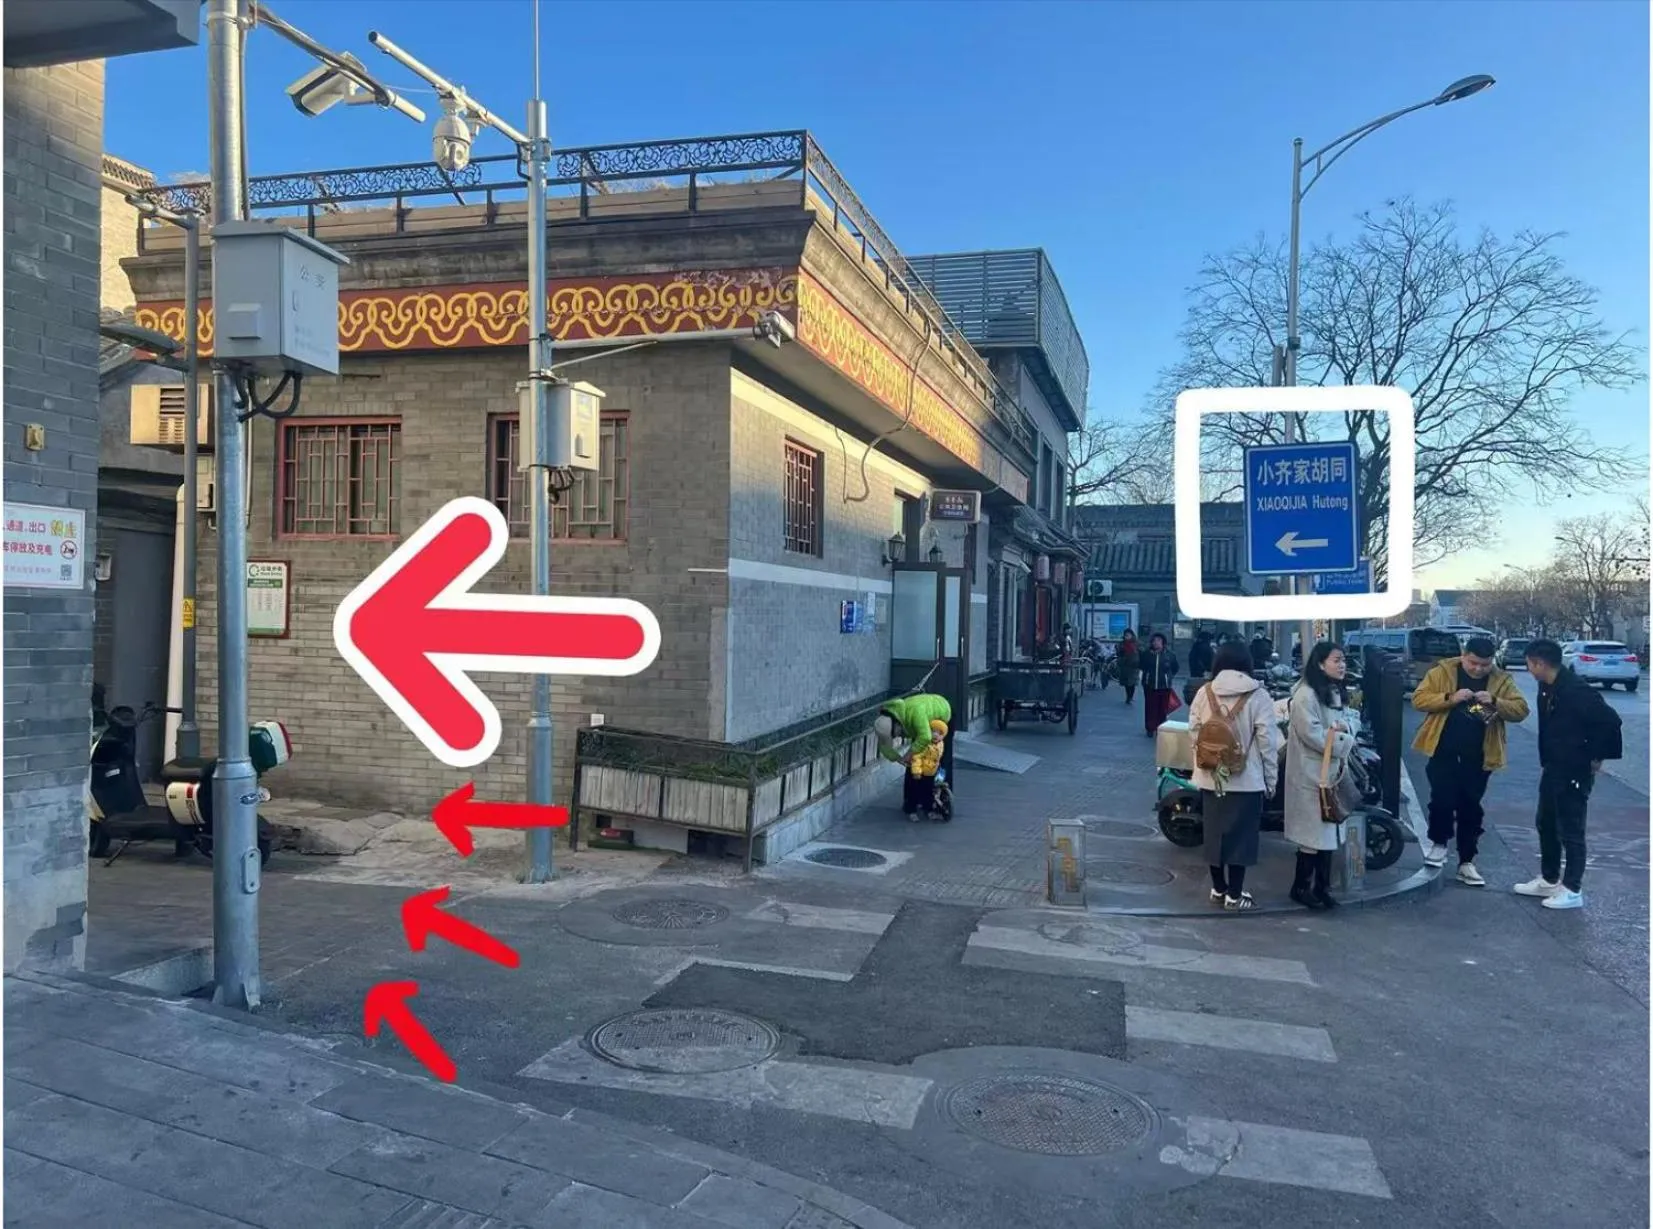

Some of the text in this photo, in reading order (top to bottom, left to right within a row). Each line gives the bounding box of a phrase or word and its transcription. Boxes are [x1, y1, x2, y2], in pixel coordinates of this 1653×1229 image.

[1257, 456, 1347, 486] 小齐家胡同
[1256, 495, 1349, 511] XIAOQIJIA Hutong
